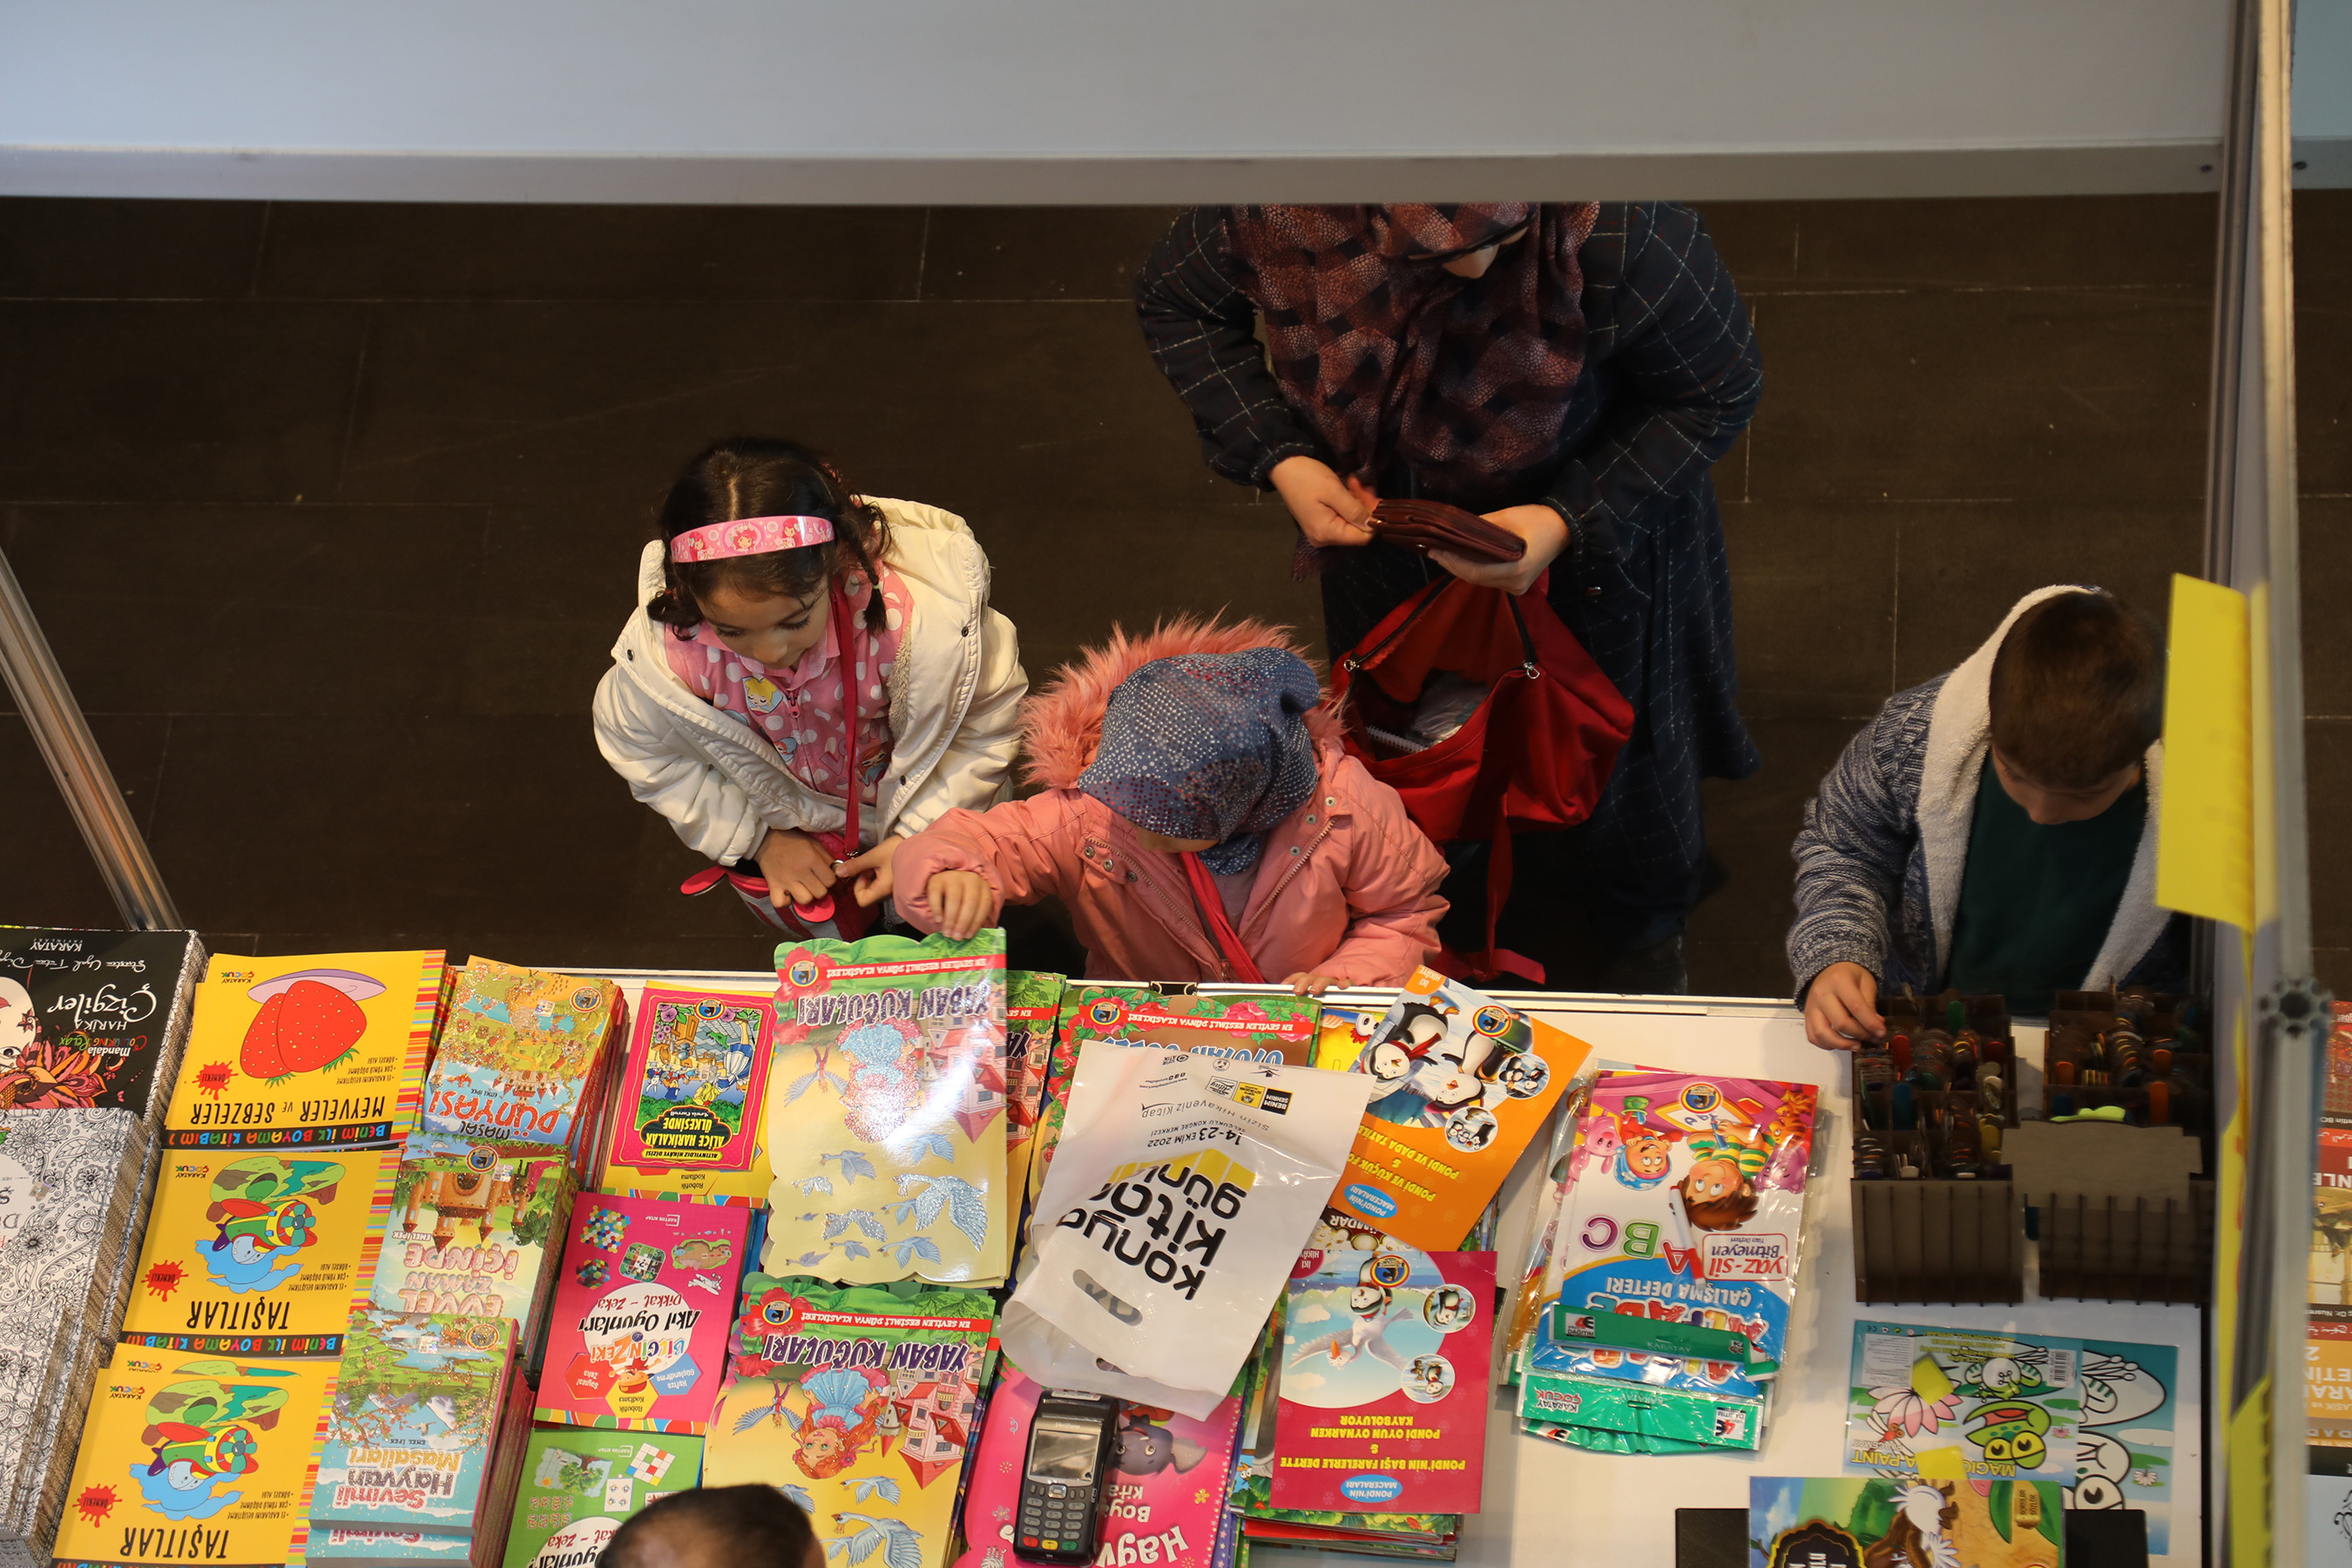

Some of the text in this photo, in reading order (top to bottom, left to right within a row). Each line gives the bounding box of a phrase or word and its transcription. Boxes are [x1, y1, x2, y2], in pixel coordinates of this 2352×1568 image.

[29, 943, 83, 952] KARATAY
[46, 983, 157, 1023] Çizgiler
[795, 984, 990, 1026] YABAN KUĞULARI
[74, 1019, 128, 1032] HARİKA
[1128, 1013, 1178, 1025] KLASİKLERİ
[1179, 1017, 1208, 1027] DÜNYA
[1209, 1020, 1245, 1029] RESİMLİ
[87, 1047, 132, 1058] Mandala
[191, 1096, 385, 1124] MEYVELER VE SEBZELER
[427, 1090, 560, 1137] DÜNYASI
[460, 1121, 510, 1139] MASAL
[663, 1118, 712, 1132] ÜLKESİNDE
[1181, 1120, 1206, 1130] KONGRE
[1240, 1115, 1269, 1131] Sizin
[181, 1125, 386, 1147] BENİM İLK BOYAMA KİTABIM
[645, 1133, 725, 1149] ALİCE HARİKALAR
[1147, 1127, 1243, 1147] 14-23 EKİM 2022
[1357, 1125, 1459, 1179] PONDİ VE DADA TATİLD
[1360, 1159, 1393, 1179] KÜÇÜK
[1394, 1175, 1405, 1186] VE
[1350, 1186, 1396, 1211] MACERALARI
[1402, 1182, 1436, 1202] PONDİ
[1582, 1216, 1690, 1274] A B C
[1712, 1244, 1780, 1258] Bitmeyen
[404, 1243, 519, 1281] İÇİNDE
[1708, 1256, 1785, 1277] yaz-sil
[405, 1272, 493, 1294] ZAMAN
[1605, 1277, 1673, 1296] DEFTERİ
[398, 1289, 504, 1317] EVVEL
[598, 1294, 682, 1311] Dikkat Zeka
[186, 1297, 290, 1329] TAŞITLAR
[801, 1313, 852, 1322] KLASİKLERİ
[855, 1316, 884, 1325] DÜNYA
[578, 1310, 701, 1335] Akıl Oyunları
[923, 1320, 958, 1328] SEVİLEN
[193, 1338, 262, 1352] BOYAMA
[267, 1339, 287, 1355] İLK
[291, 1336, 337, 1354] BENİM
[761, 1335, 969, 1372] YABAN KUĞULARI
[1535, 1390, 1581, 1404] ÇOCUK
[1538, 1401, 1577, 1411] KARATAY
[1340, 1415, 1414, 1425] KAYBOLUYOR
[1310, 1427, 1441, 1442] PONDİ OYUN OYNARKEN
[349, 1450, 460, 1471] Masalları
[1281, 1456, 1466, 1472] PONDİ'NİN BAŞI FARELERLE DERTTE
[1851, 1450, 1900, 1466] PAINT
[348, 1467, 454, 1496] Hayvan
[1346, 1480, 1397, 1490] MACERALARI
[336, 1486, 426, 1509] Sevimli
[1349, 1489, 1393, 1498] PONDİ'NİN
[119, 1524, 229, 1558] TAŞITLAR
[548, 1534, 577, 1549] Zeka
